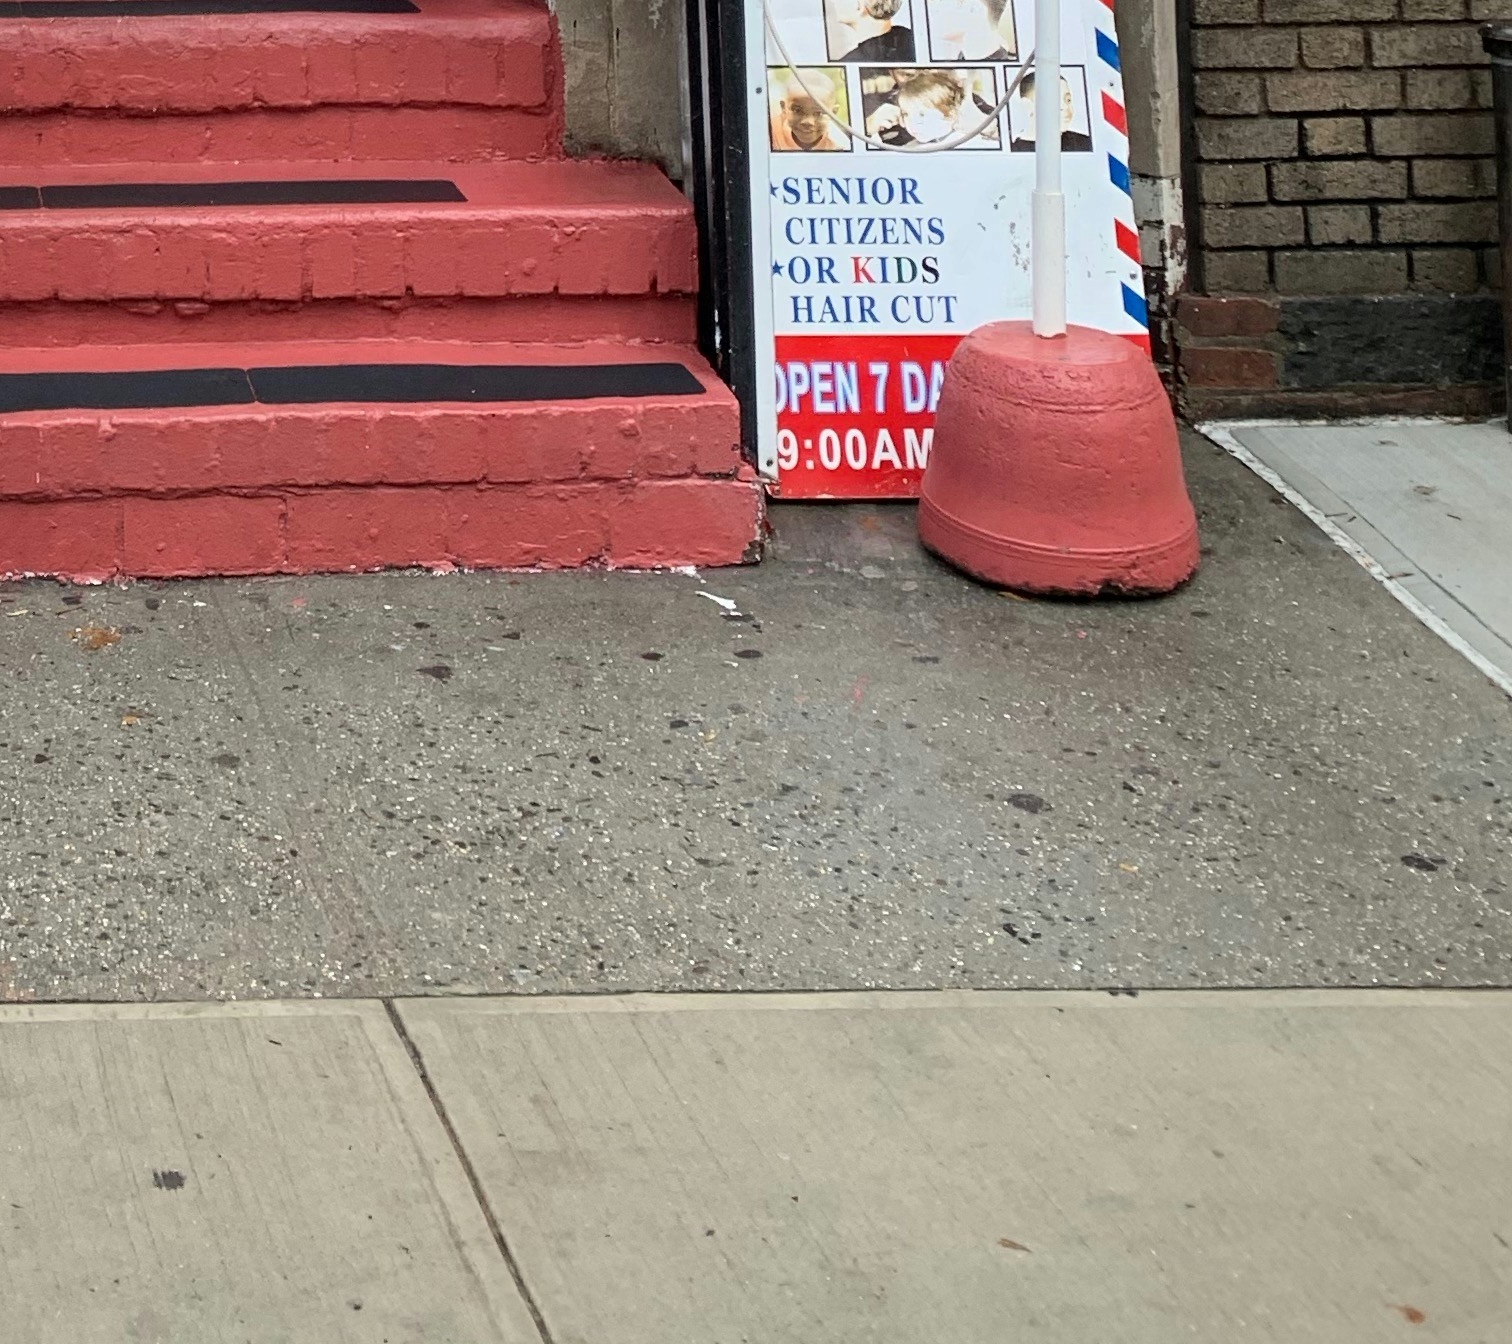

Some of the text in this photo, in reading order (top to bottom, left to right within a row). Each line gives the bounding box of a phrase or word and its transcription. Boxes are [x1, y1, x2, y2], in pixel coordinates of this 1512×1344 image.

[782, 177, 924, 205] SENIOR
[785, 217, 946, 246] CITIZENS
[788, 256, 940, 285] OR KIDS
[790, 295, 958, 324] HAIR CUT
[868, 362, 890, 414] 7
